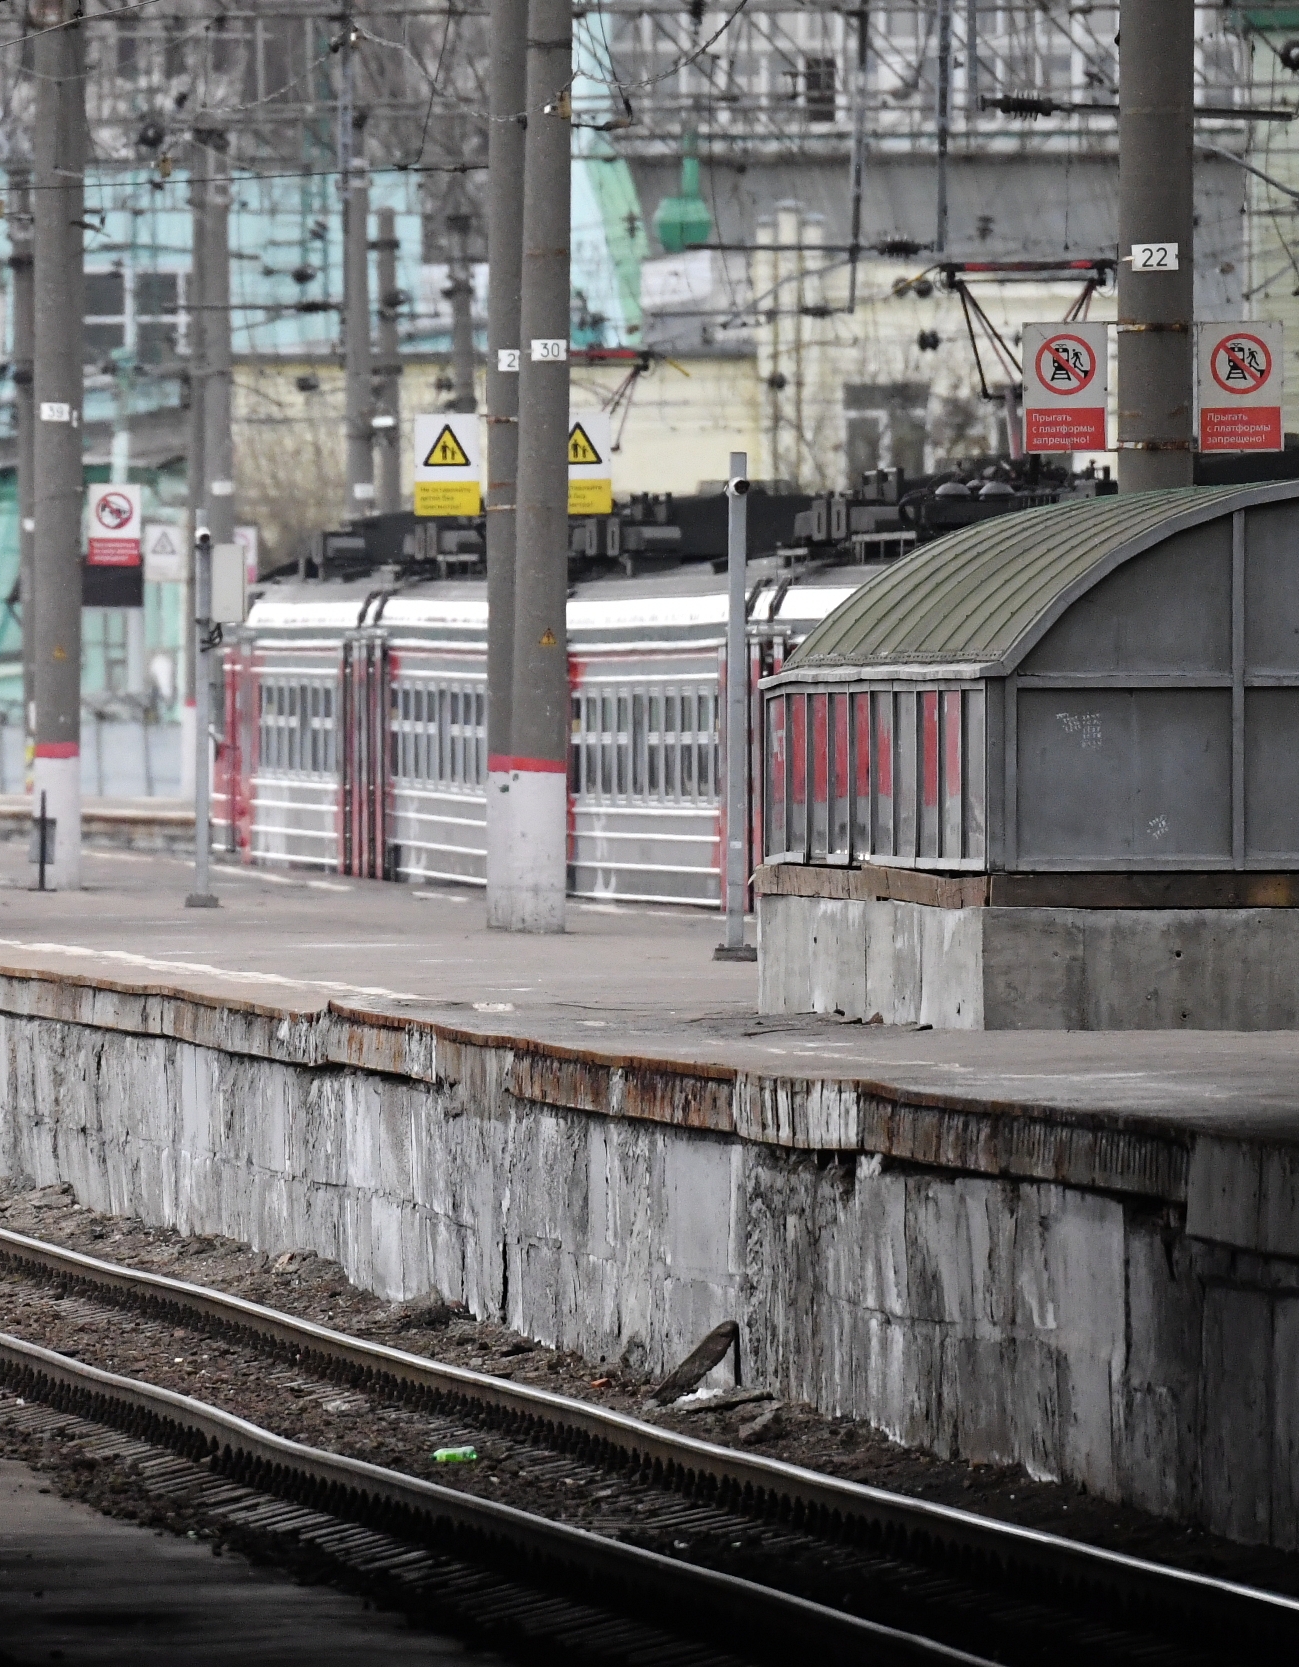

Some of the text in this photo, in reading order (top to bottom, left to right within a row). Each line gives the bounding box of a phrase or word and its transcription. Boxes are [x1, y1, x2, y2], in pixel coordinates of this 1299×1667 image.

[1141, 247, 1168, 268] 22
[540, 342, 560, 358] 30
[507, 353, 517, 368] 2
[1032, 413, 1072, 423] Прыгать
[1207, 412, 1248, 423] Прыгать
[1039, 424, 1095, 434] платформы
[1214, 423, 1271, 434] платформы
[1032, 435, 1090, 445] запрещено!
[1207, 434, 1266, 445] запрещено!
